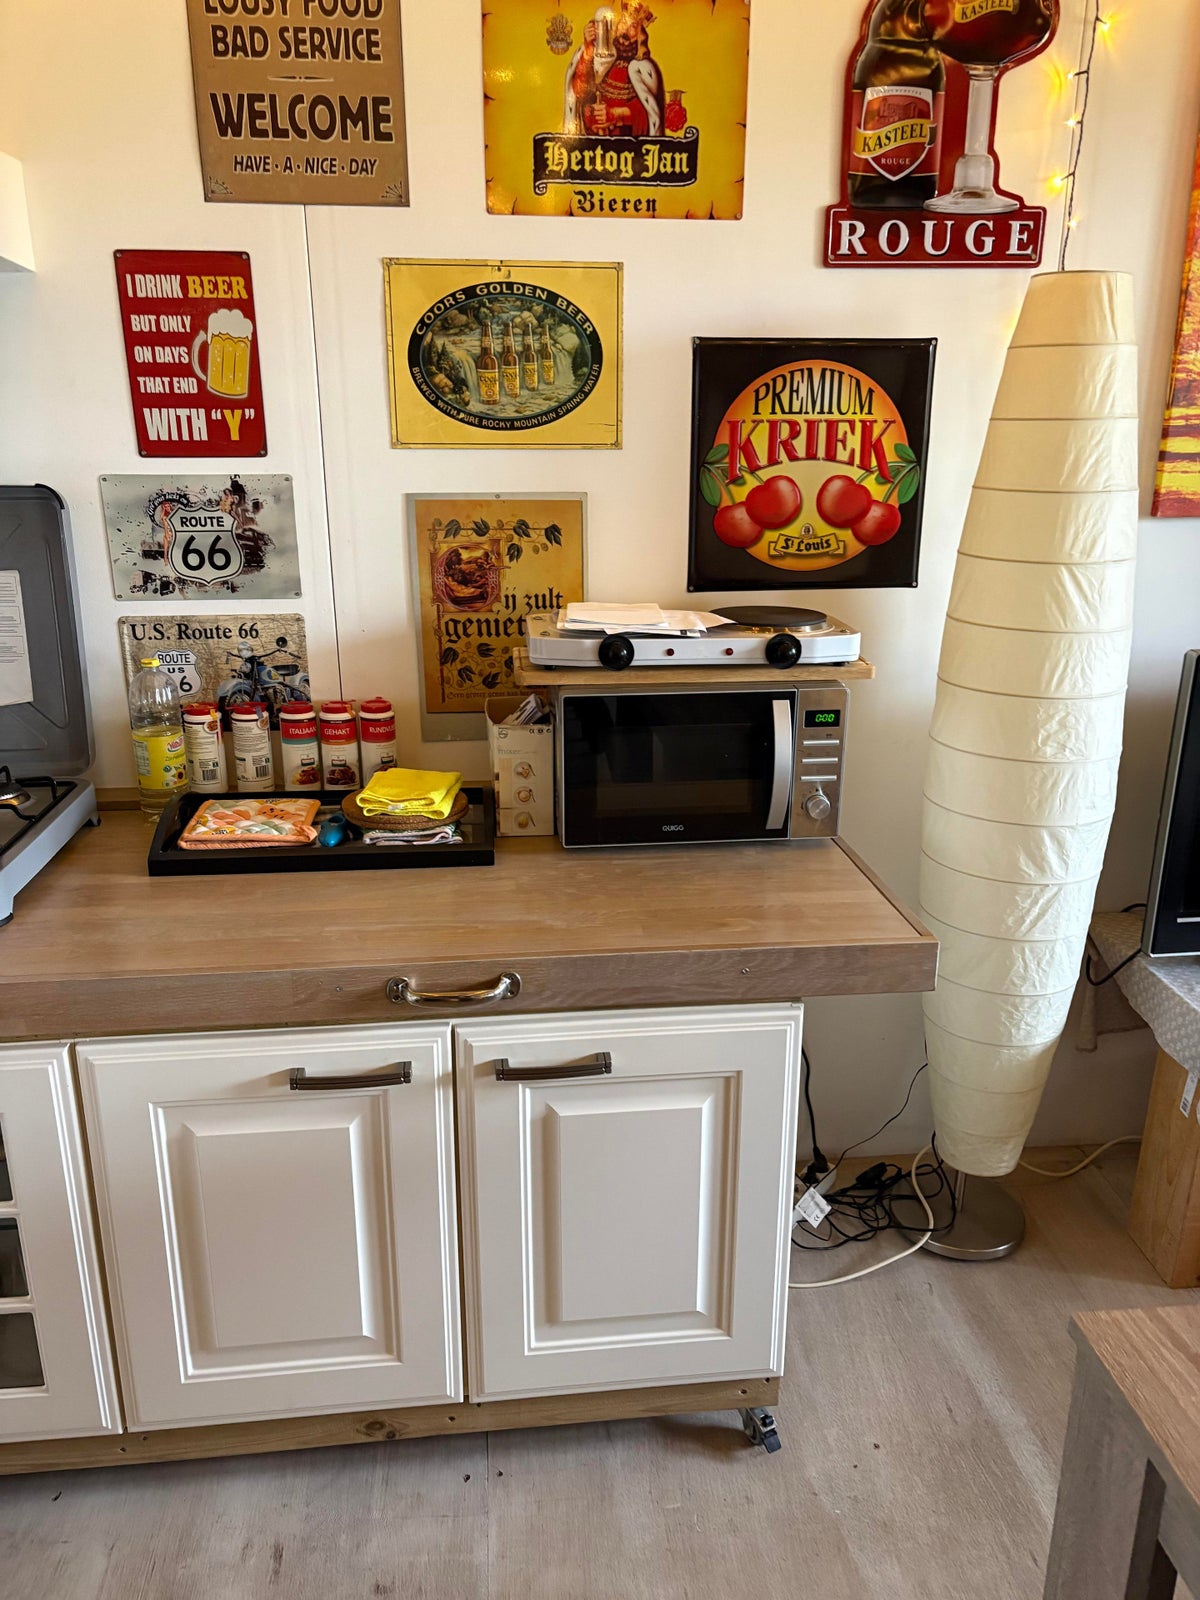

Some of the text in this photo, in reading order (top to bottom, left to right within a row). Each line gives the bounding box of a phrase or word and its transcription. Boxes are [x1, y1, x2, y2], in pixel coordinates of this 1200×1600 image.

[211, 24, 383, 61] BAD SERVICE
[209, 92, 394, 141] WELCOME
[862, 123, 927, 152] KASTEEL
[234, 155, 377, 175] HAVE A NICE DAY
[544, 141, 690, 178] Hertog Jan
[881, 157, 911, 165] ROUGE
[573, 189, 657, 213] Bieren
[836, 219, 1034, 256] ROUGE
[126, 274, 249, 299] I DRINK BEER
[416, 283, 594, 335] COORS GOLDEN BEER
[130, 314, 191, 333] BUT ONLY
[134, 346, 189, 363] ON DAYS
[137, 376, 198, 394] THAT END
[412, 363, 600, 428] BREWED WITH PURE ROCKY MOUNTAIN SPRING WATER
[753, 367, 875, 416] PREMIUM
[143, 408, 208, 441] WITH
[725, 418, 896, 484] KRIEK
[180, 516, 225, 528] ROUTE
[182, 535, 231, 571] 66
[796, 537, 831, 552] Louis
[524, 587, 563, 615] zult
[129, 622, 259, 640] U.S. Route 66
[445, 610, 526, 644] geniet
[158, 653, 191, 663] ROUTE
[176, 675, 193, 692] 6
